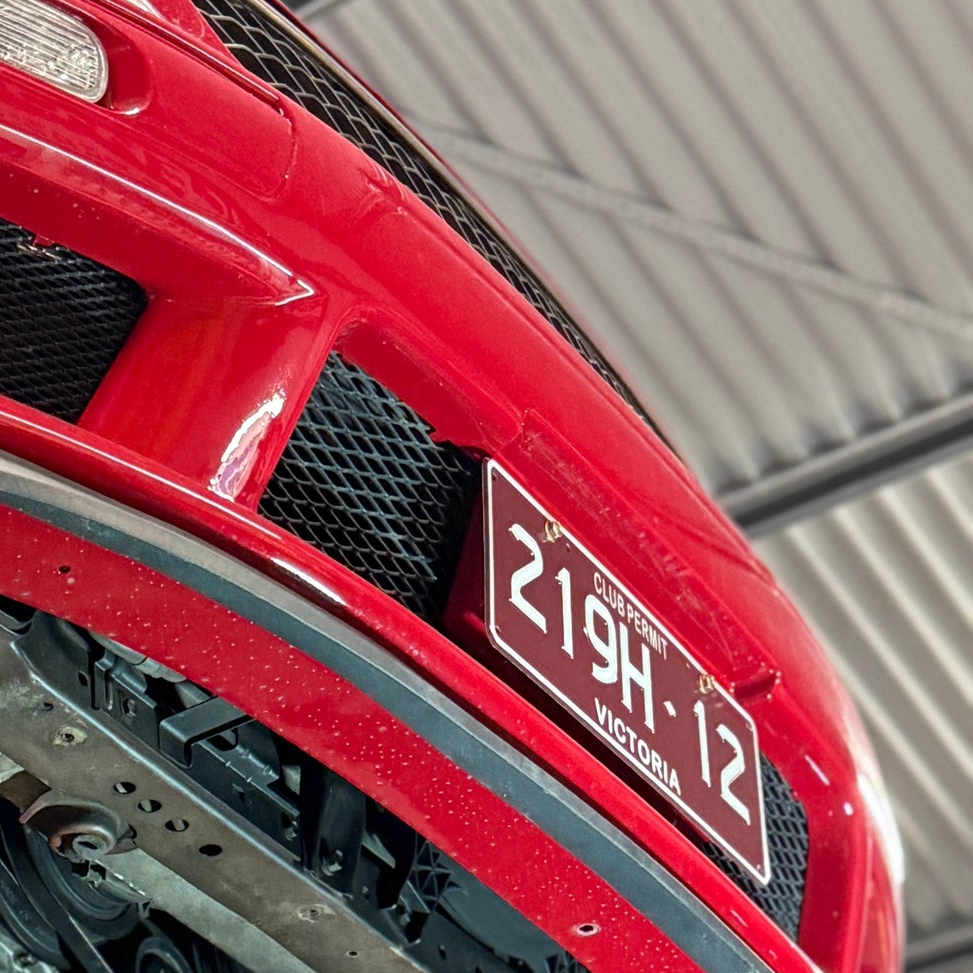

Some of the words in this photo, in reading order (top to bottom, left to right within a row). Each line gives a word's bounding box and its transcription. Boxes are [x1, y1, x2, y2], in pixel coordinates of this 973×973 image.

[593, 571, 626, 618] CLUB
[626, 602, 668, 661] PERMIT
[594, 697, 682, 797] VICTORIA
